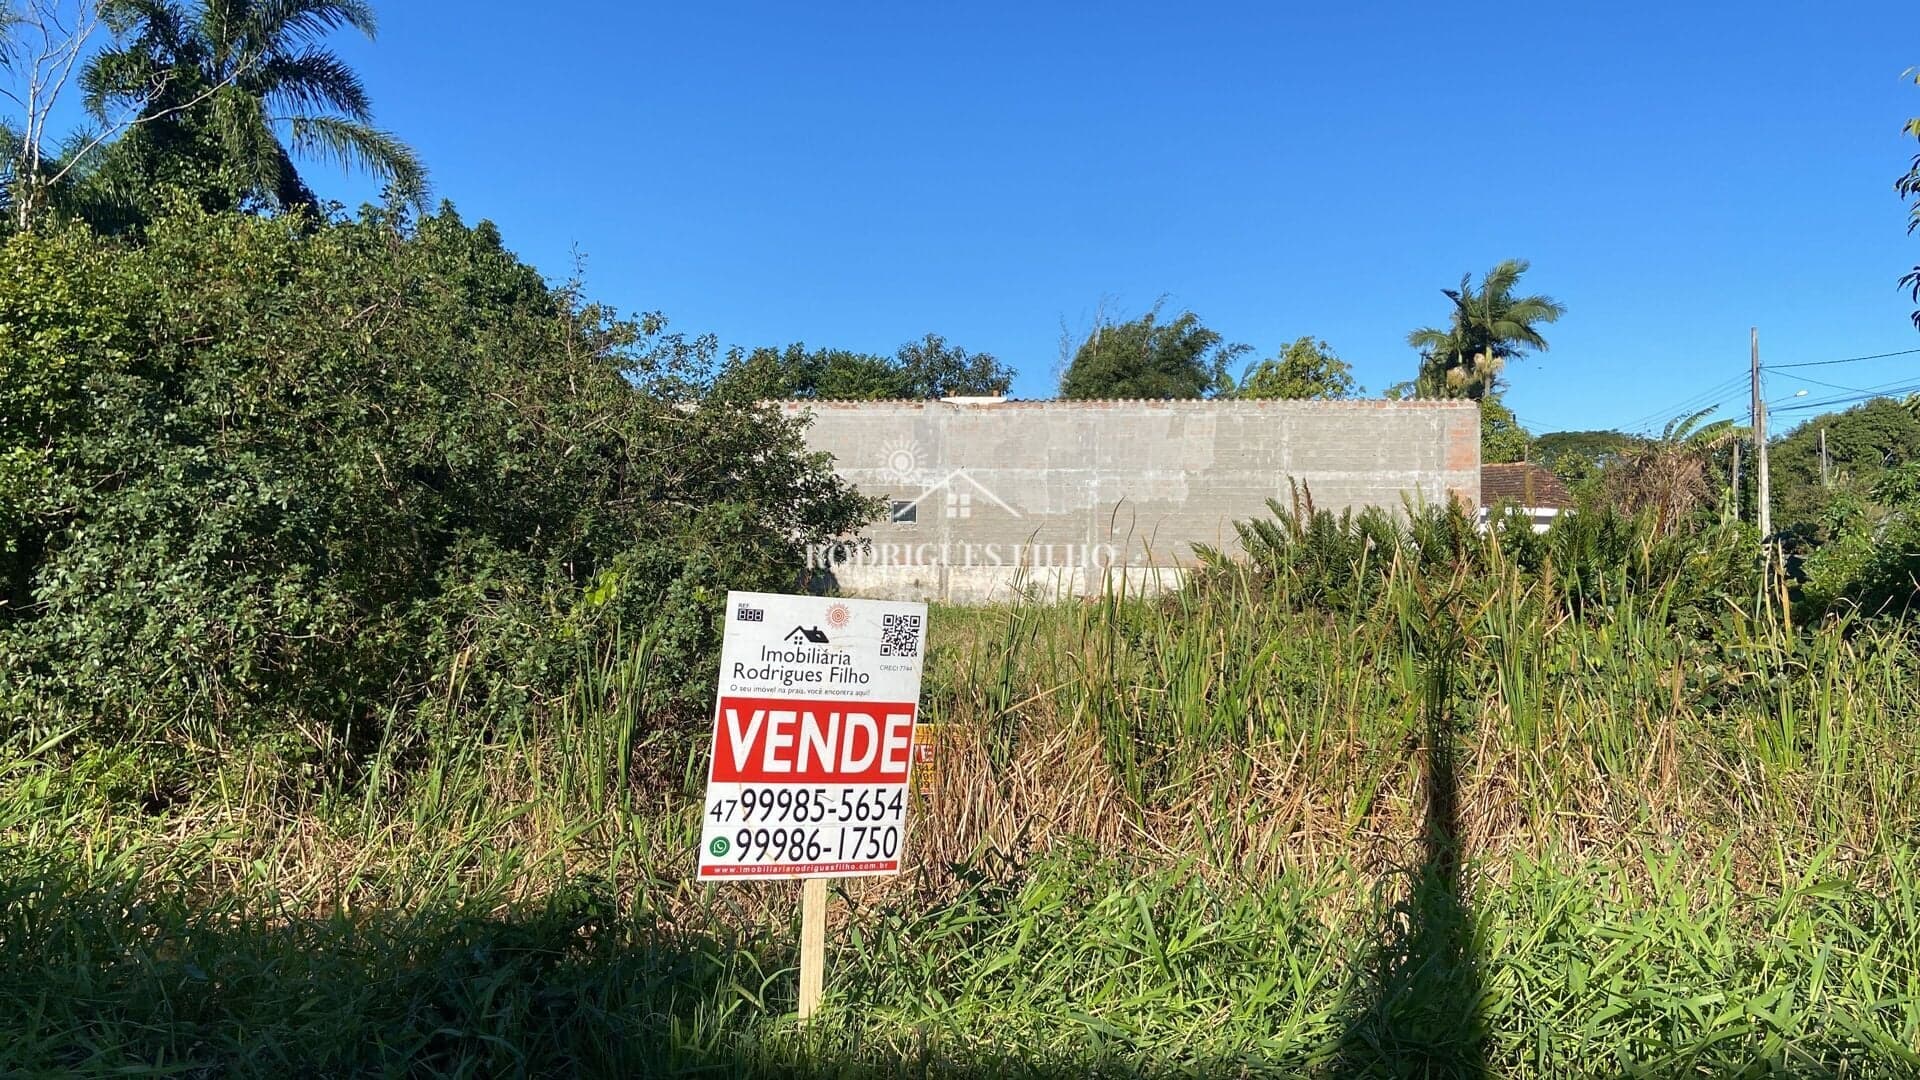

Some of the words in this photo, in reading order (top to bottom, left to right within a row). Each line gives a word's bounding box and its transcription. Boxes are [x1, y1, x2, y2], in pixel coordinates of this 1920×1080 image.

[761, 645, 851, 666] Imobiliária
[733, 662, 823, 686] Rodrigues
[829, 666, 870, 684] Filho
[730, 684, 738, 692] O
[725, 709, 911, 773] VENDE
[710, 799, 738, 822] 47
[740, 787, 903, 823] 99985-5654
[736, 826, 898, 863] 99986-1750
[713, 862, 888, 873] www.imobiliariarodriguesfilho.com.br
